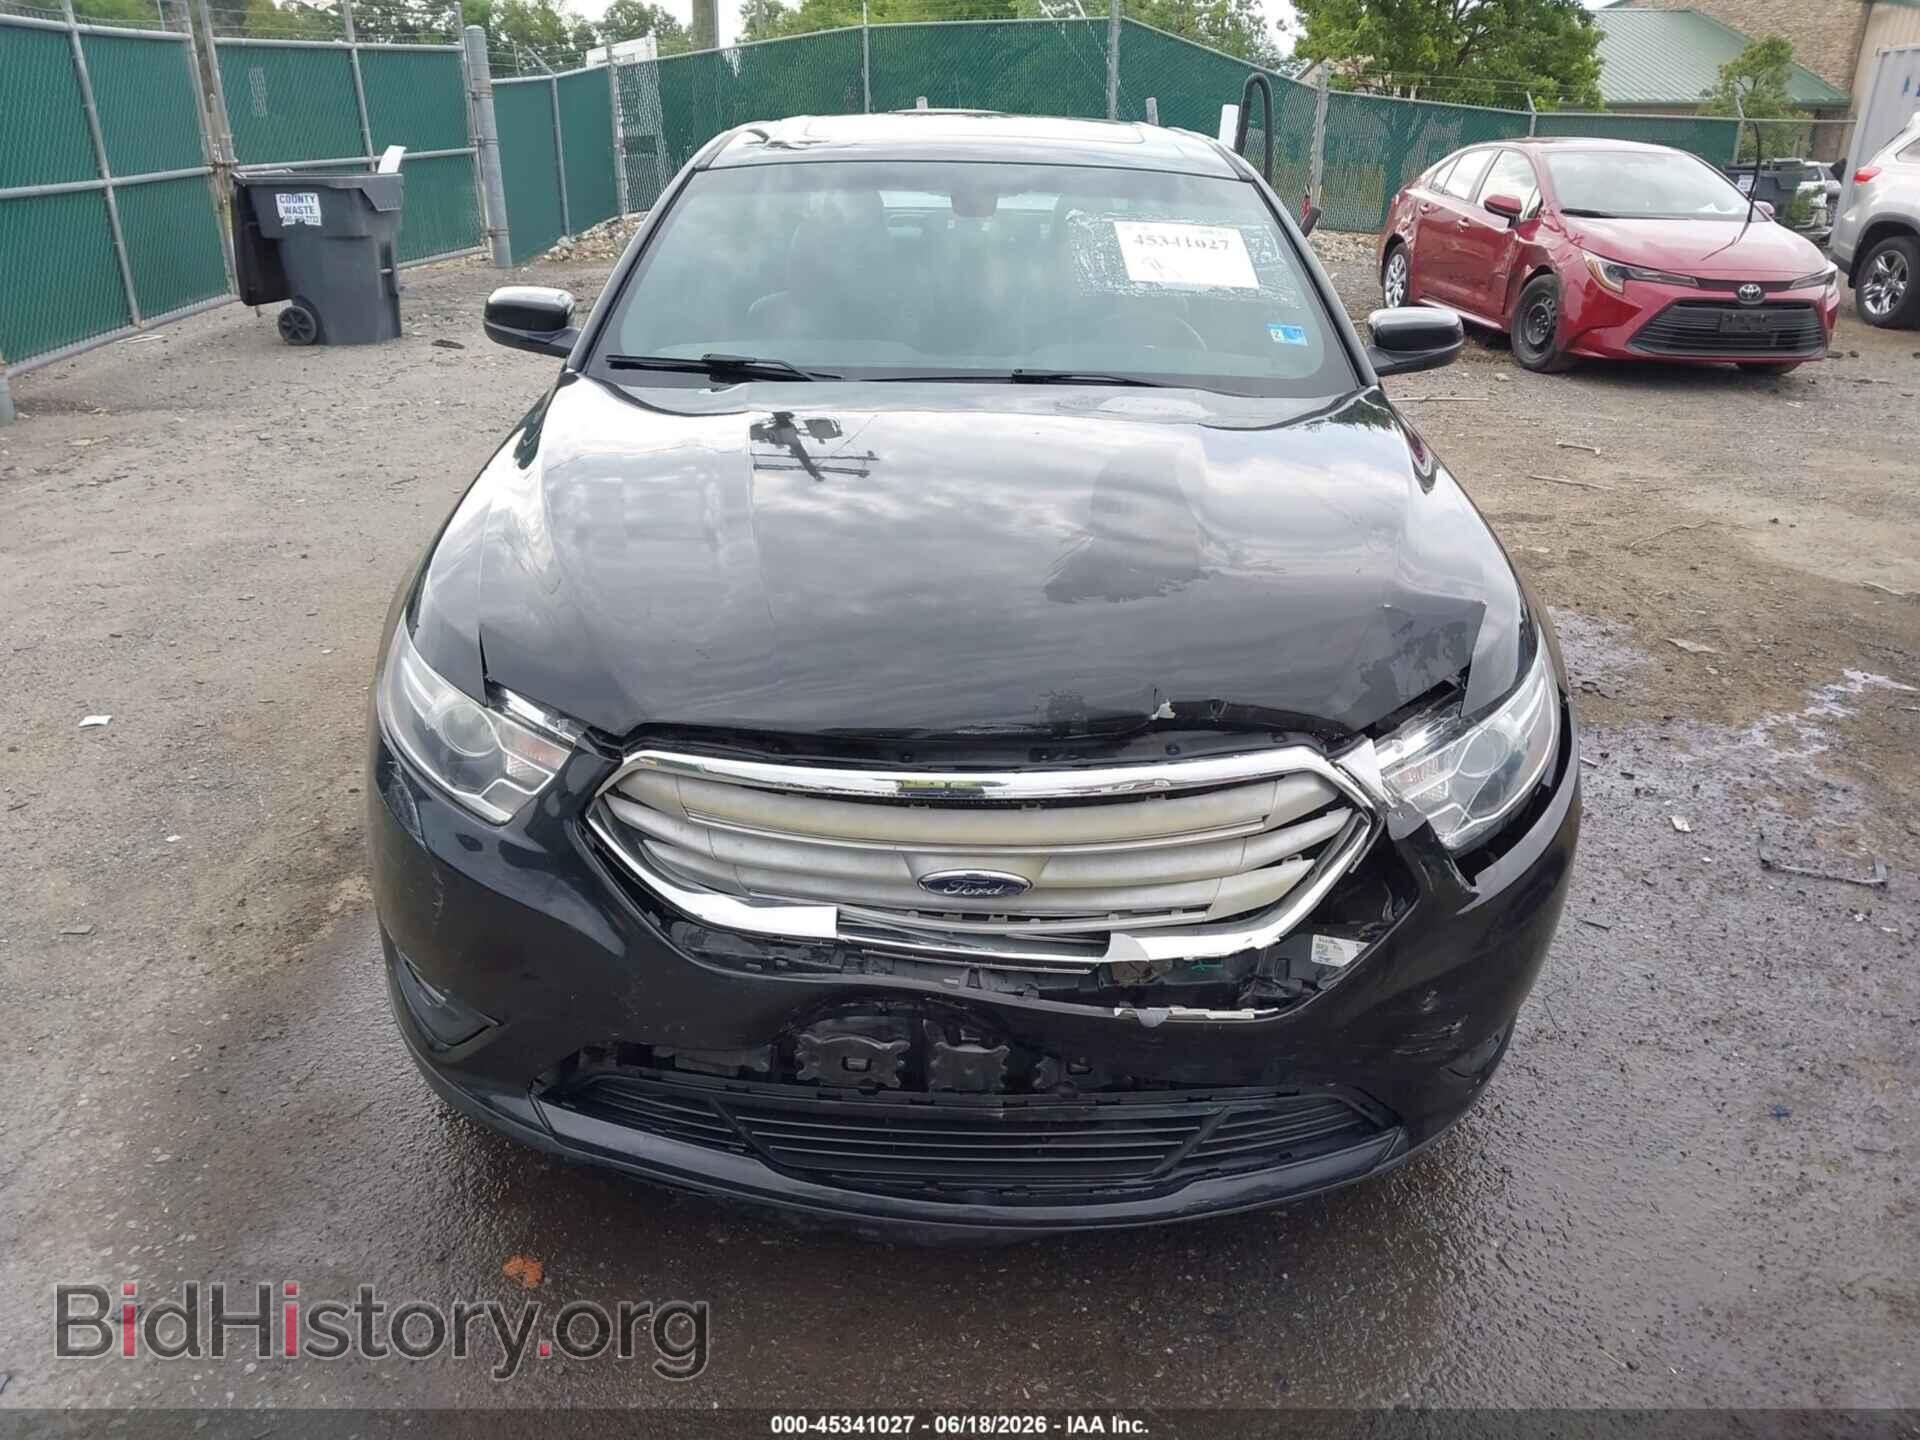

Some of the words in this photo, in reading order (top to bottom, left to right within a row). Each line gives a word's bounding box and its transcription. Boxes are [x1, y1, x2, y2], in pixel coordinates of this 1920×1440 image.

[279, 194, 315, 204] COUNTY
[283, 205, 313, 215] WASTE
[943, 880, 1005, 896] Ford
